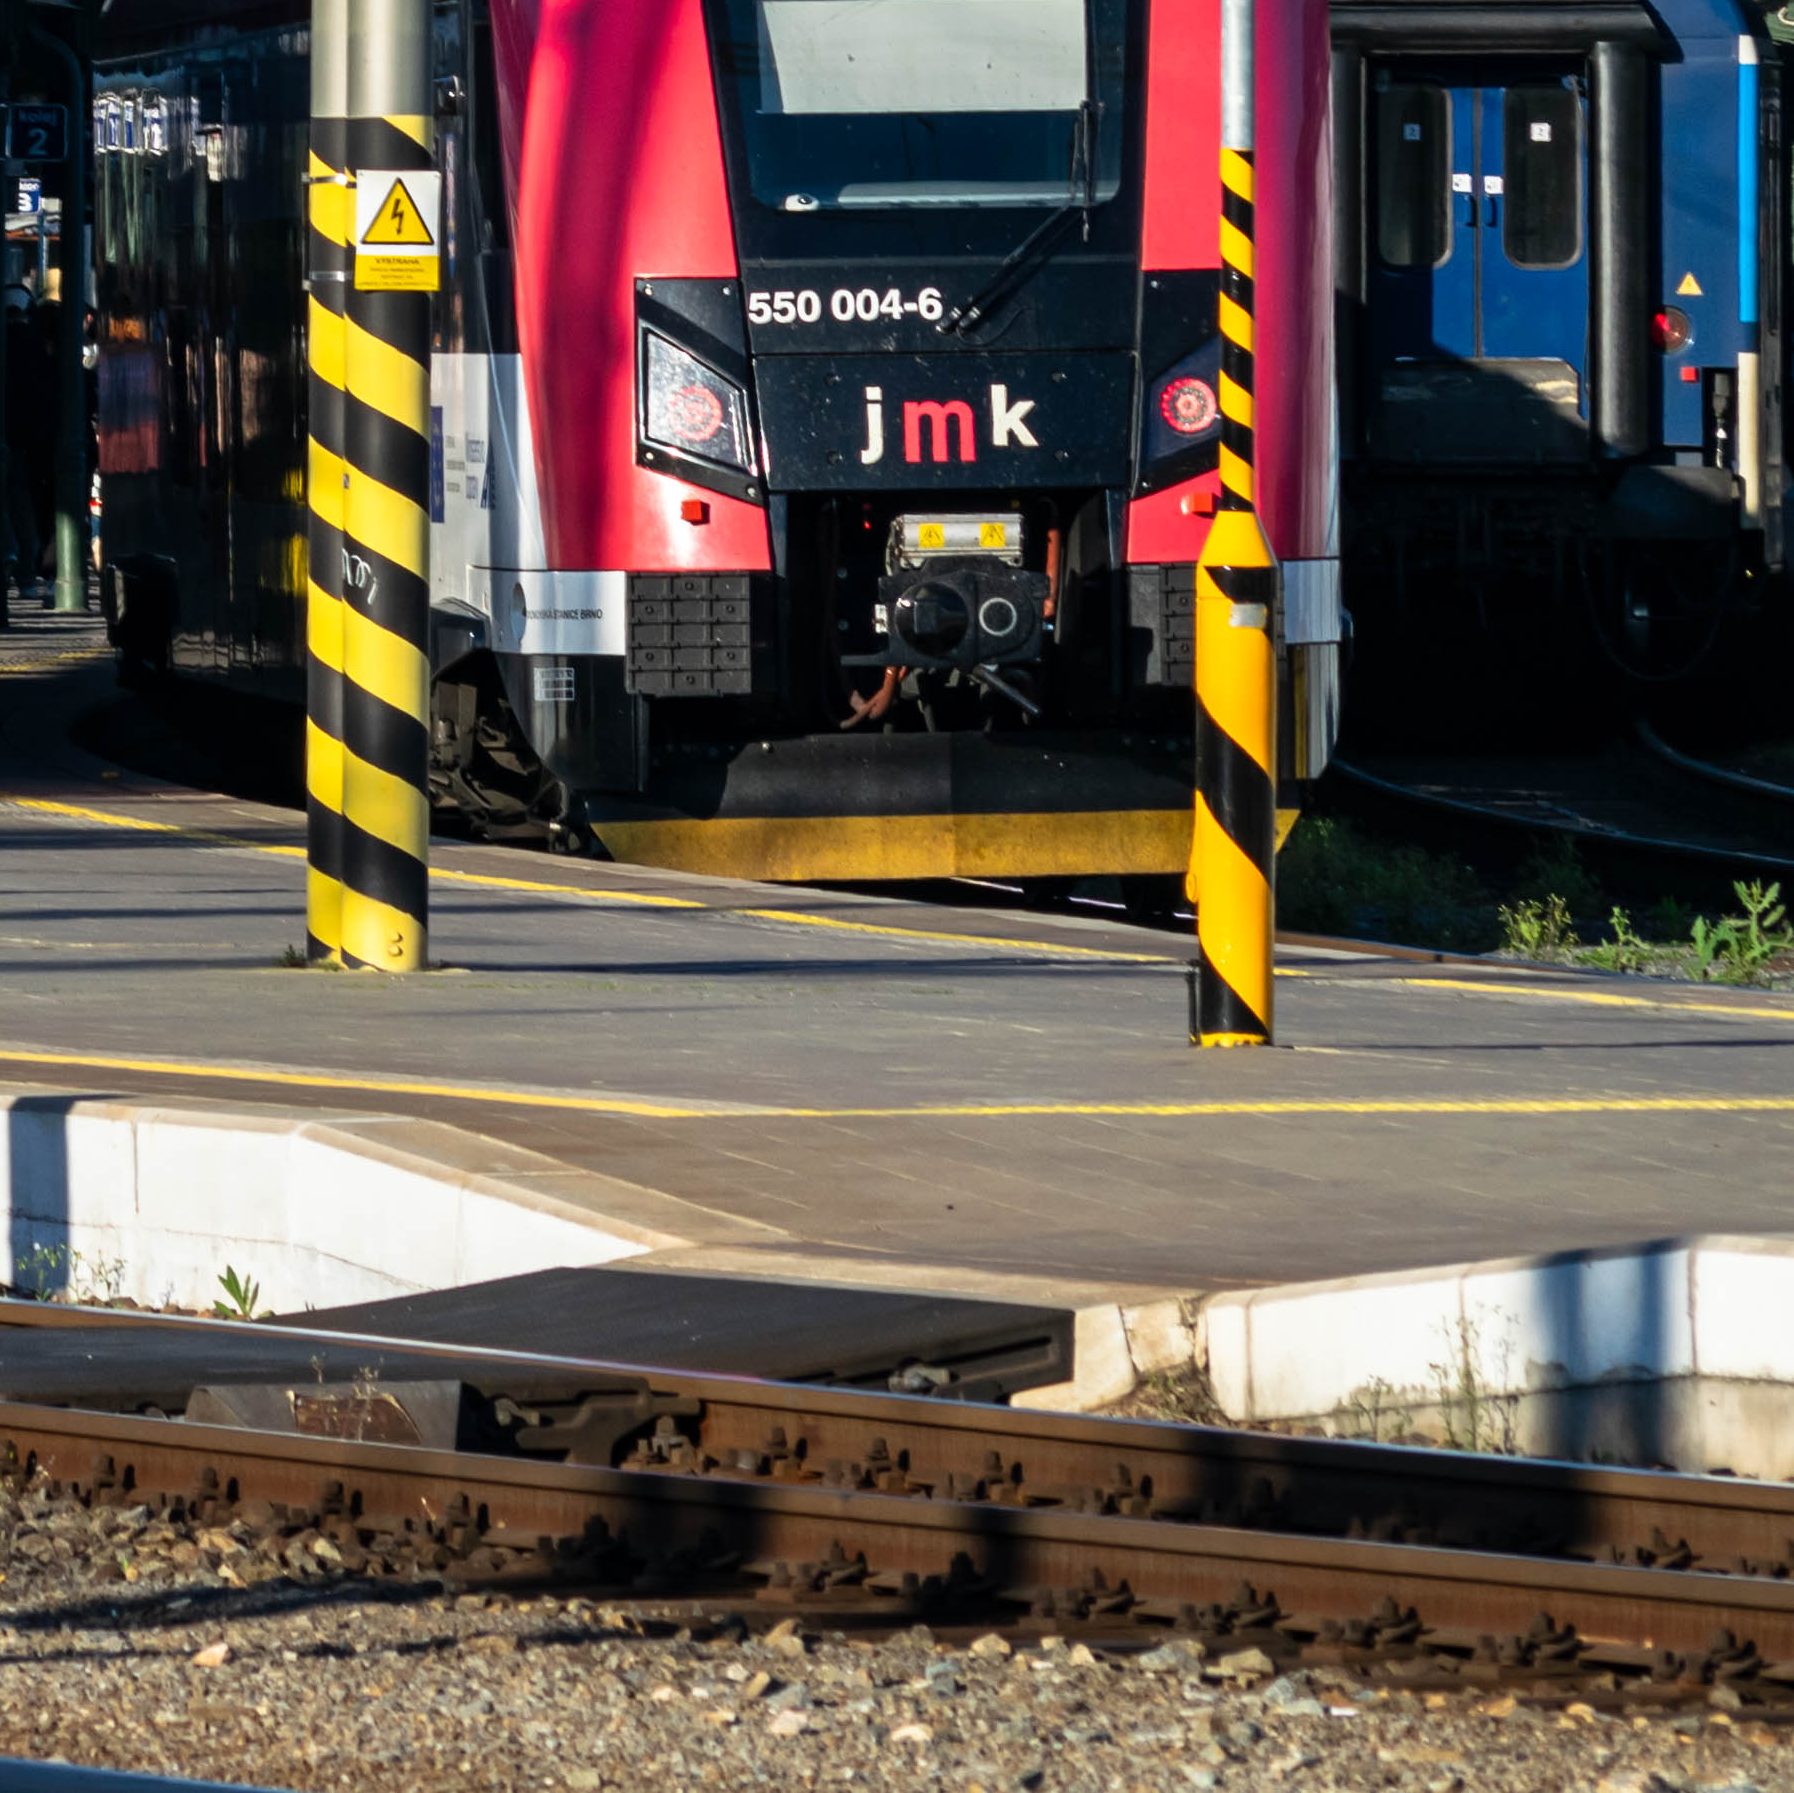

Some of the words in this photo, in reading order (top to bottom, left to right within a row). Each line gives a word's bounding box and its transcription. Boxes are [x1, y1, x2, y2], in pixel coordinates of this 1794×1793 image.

[27, 126, 50, 157] 2
[748, 289, 822, 324] 550
[830, 286, 944, 322] 004-6
[860, 383, 1040, 466] jmk
